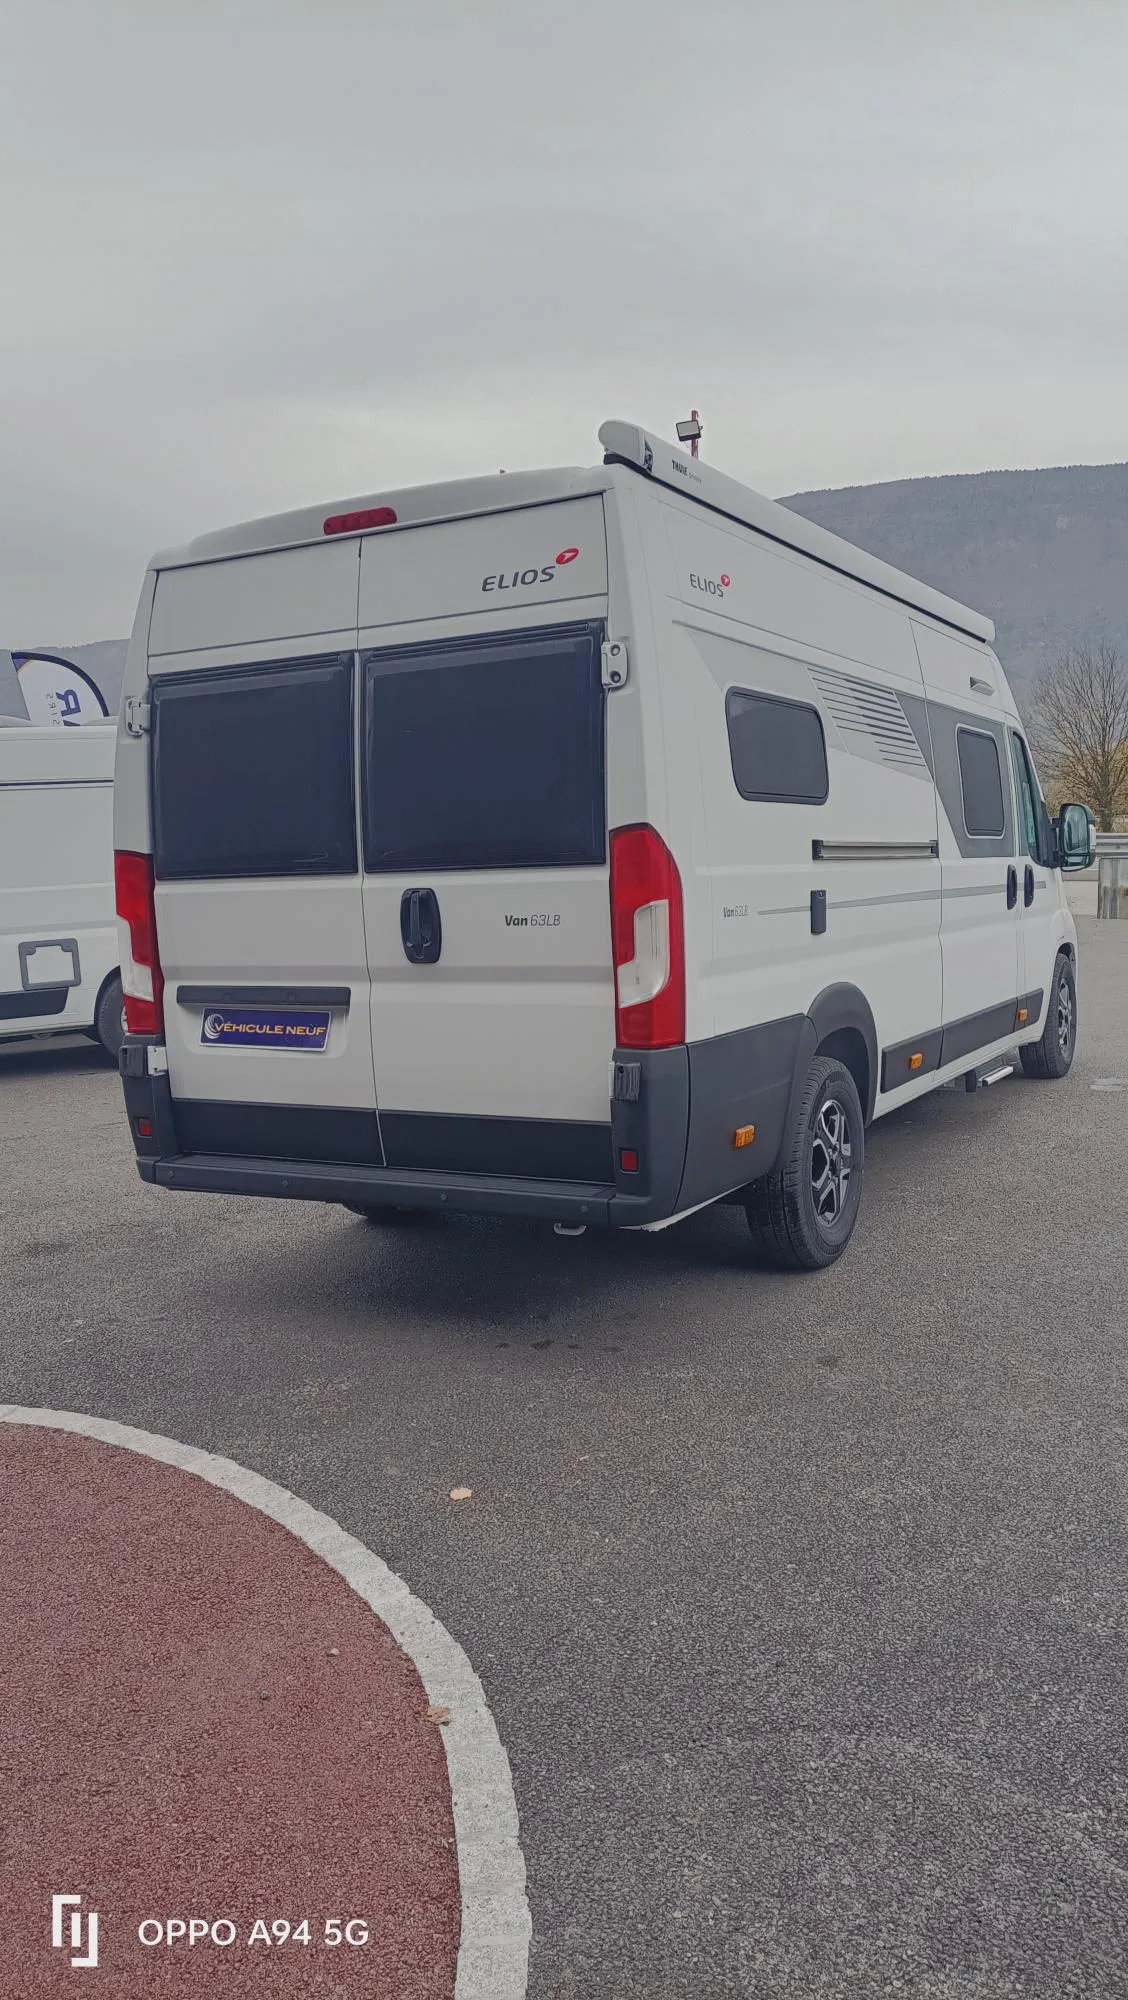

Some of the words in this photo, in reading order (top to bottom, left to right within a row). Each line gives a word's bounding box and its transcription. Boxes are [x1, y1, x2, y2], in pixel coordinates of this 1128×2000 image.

[481, 565, 556, 592] ELIOS
[690, 573, 724, 598] ELIOS
[504, 914, 528, 927] Van
[530, 914, 561, 927] 63LB
[214, 1020, 284, 1035] VÉHICULE
[285, 1026, 326, 1036] NEUF
